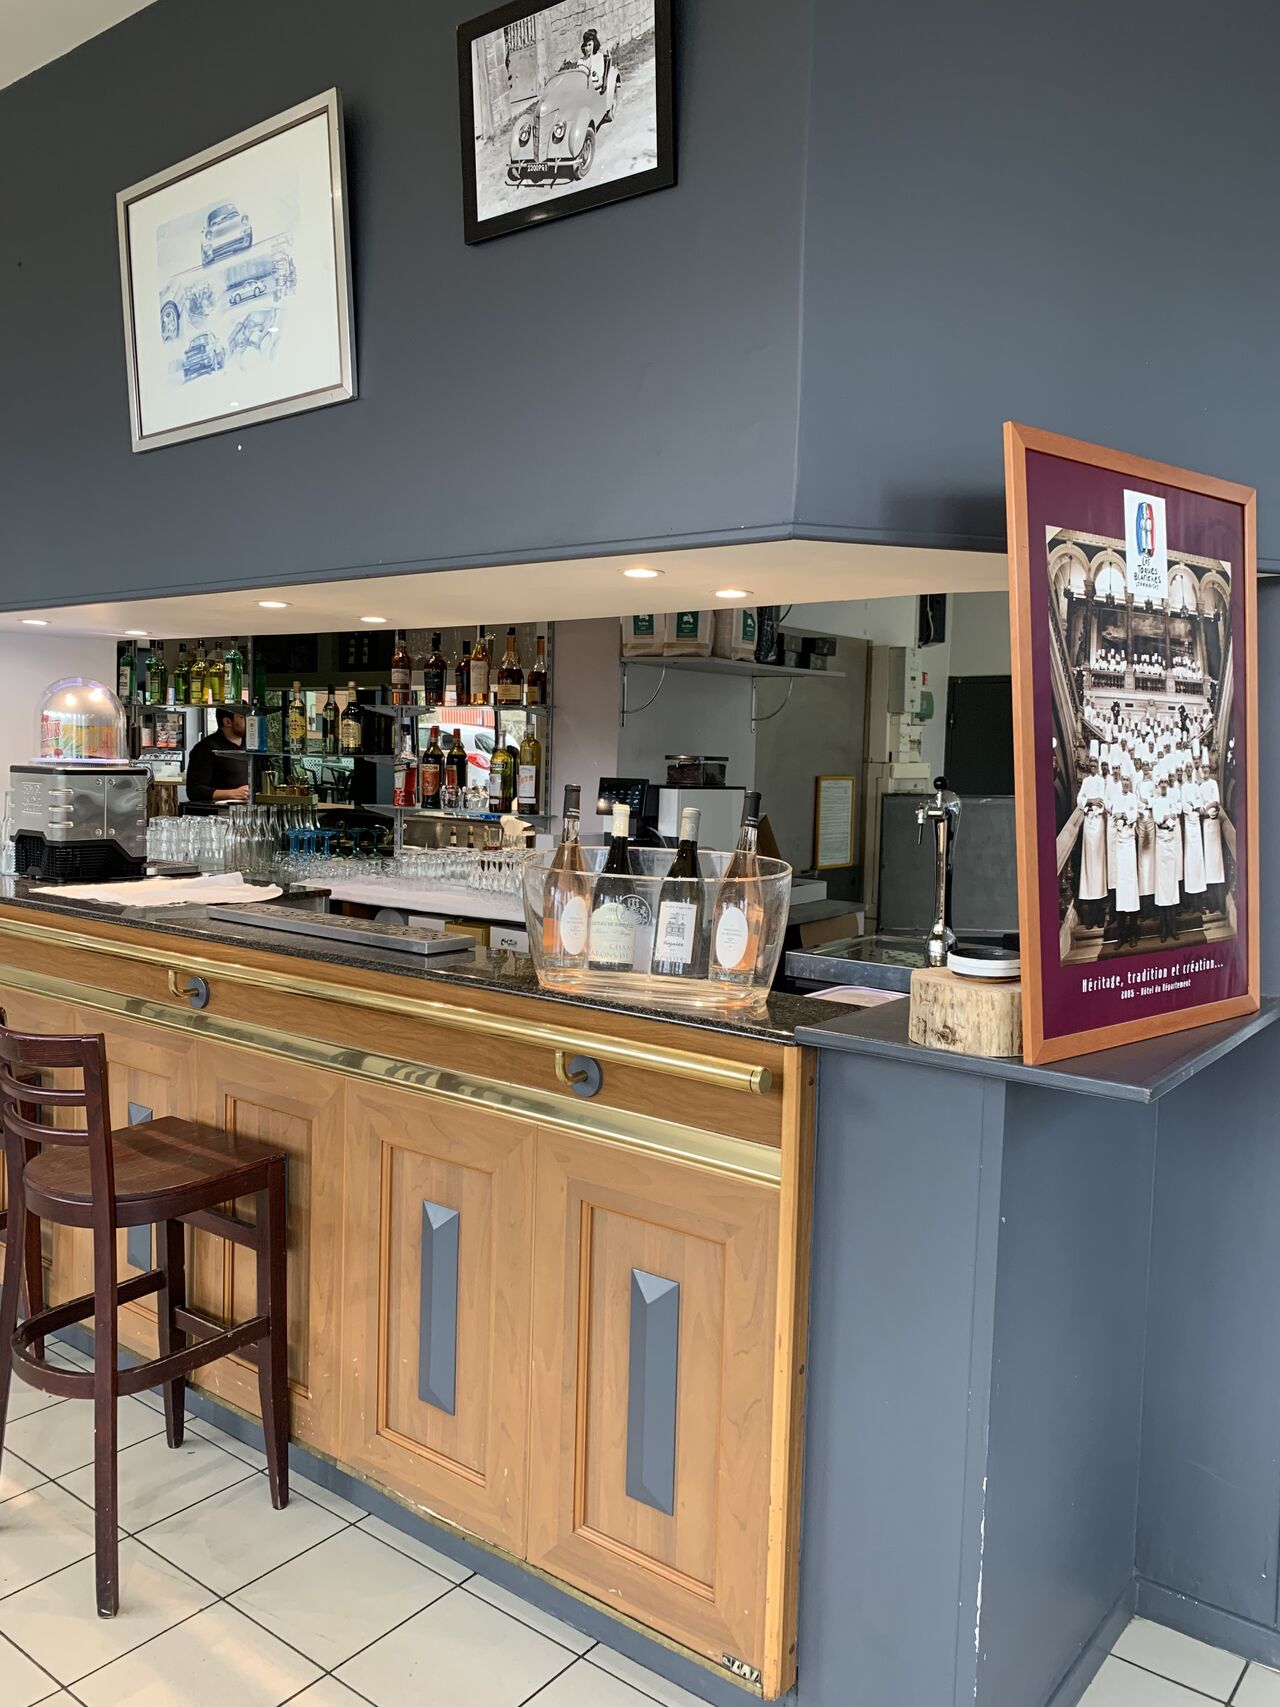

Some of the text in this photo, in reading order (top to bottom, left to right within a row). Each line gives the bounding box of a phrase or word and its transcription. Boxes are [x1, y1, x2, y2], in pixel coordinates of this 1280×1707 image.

[1082, 957, 1224, 993] Héritage, tradition et création...
[1140, 985, 1154, 996] Hôtel
[1155, 984, 1162, 993] du
[1162, 979, 1192, 992] Département
